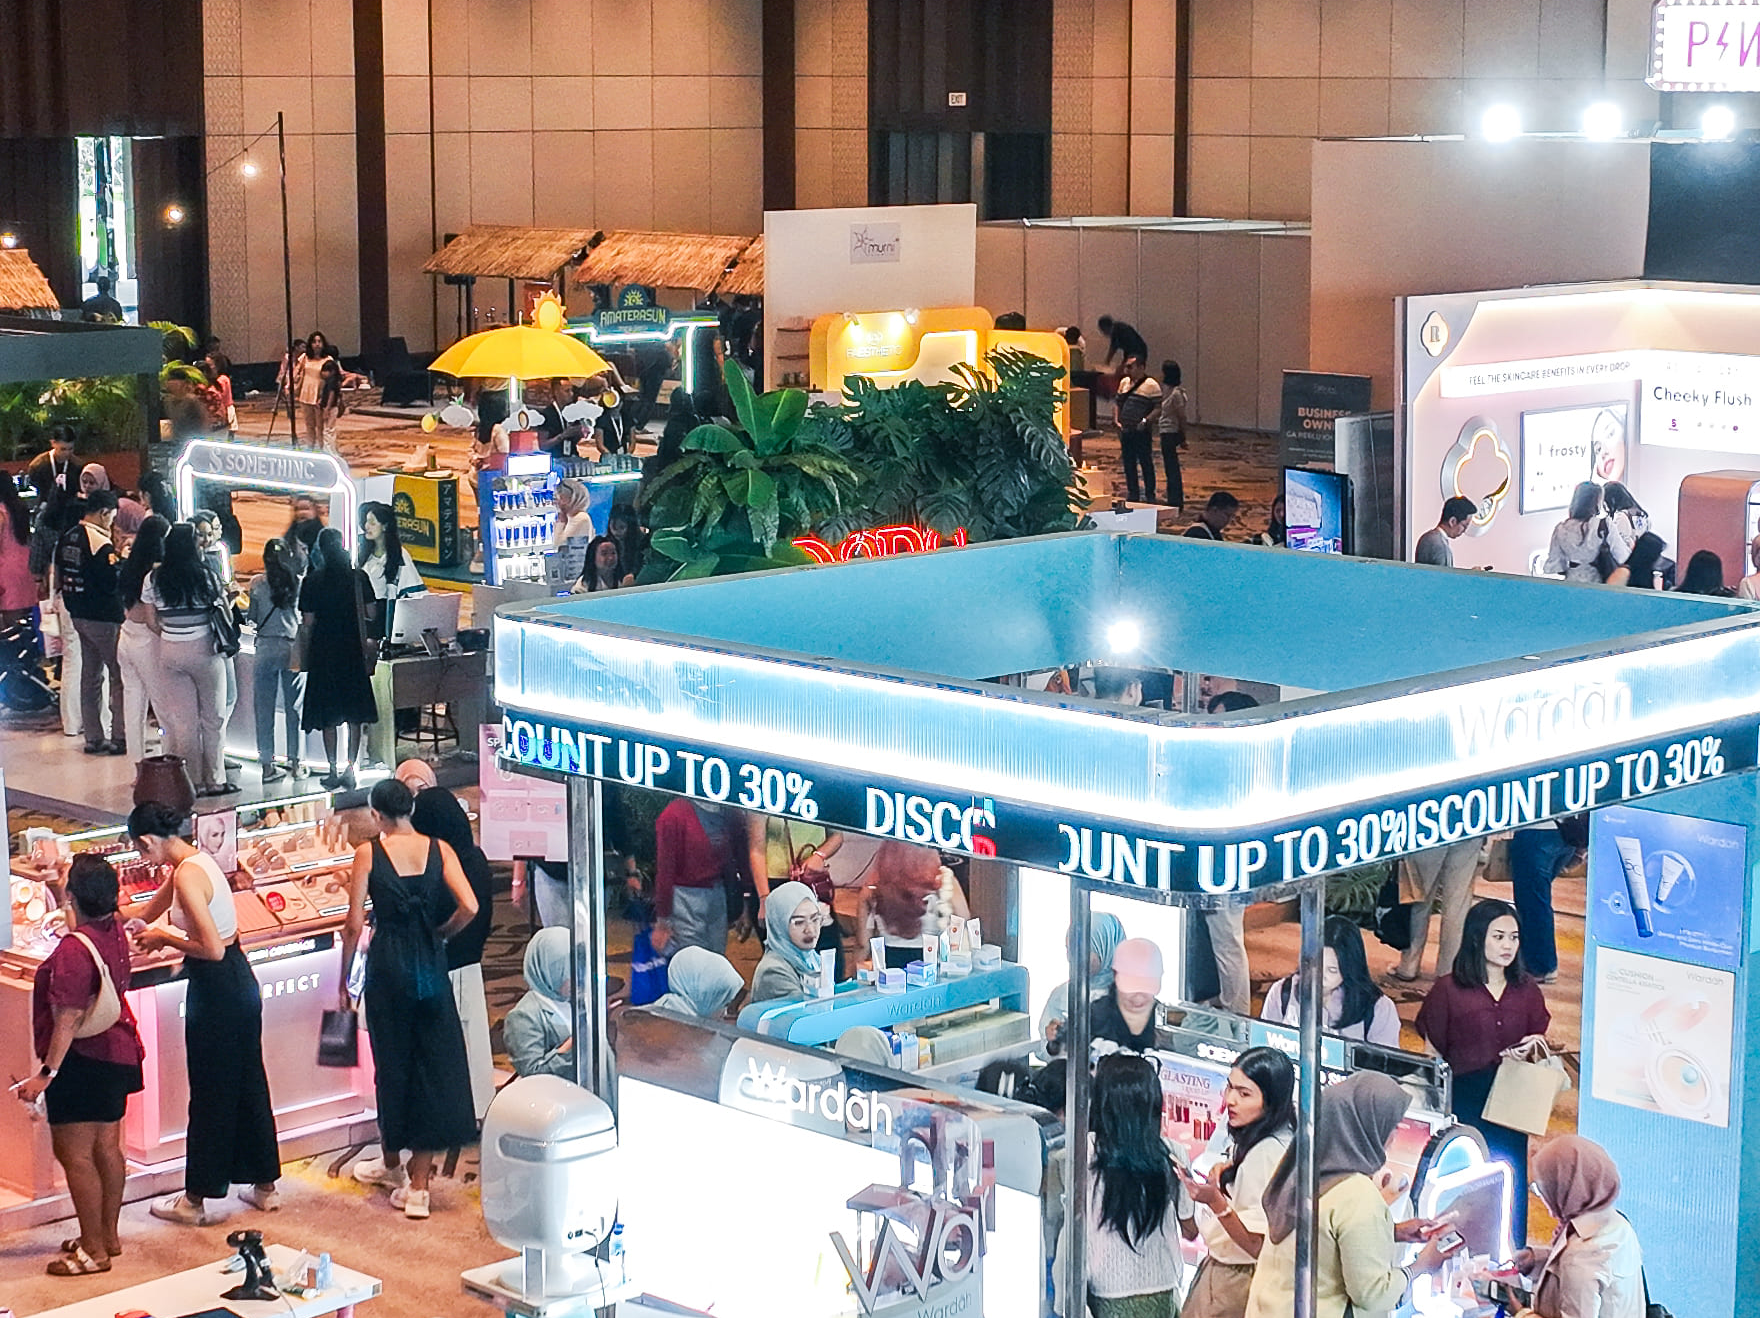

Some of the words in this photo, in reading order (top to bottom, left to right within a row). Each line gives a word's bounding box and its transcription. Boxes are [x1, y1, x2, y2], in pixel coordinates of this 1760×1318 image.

[1652, 386, 1709, 406] Cheeky
[1714, 389, 1752, 407] Flush
[1303, 418, 1336, 430] OWN
[1549, 443, 1587, 458] frosty
[225, 454, 315, 481] SOMETHINC
[618, 739, 671, 788] UP
[676, 749, 731, 802] TO
[738, 763, 819, 820] 30%
[1196, 839, 1267, 894] UP
[1273, 825, 1327, 883] TO
[1397, 770, 1559, 852] ISCOUNT
[1564, 760, 1611, 810] UP
[1614, 750, 1659, 801] TO
[1664, 735, 1725, 789] 30%
[262, 973, 320, 1000] RFECT
